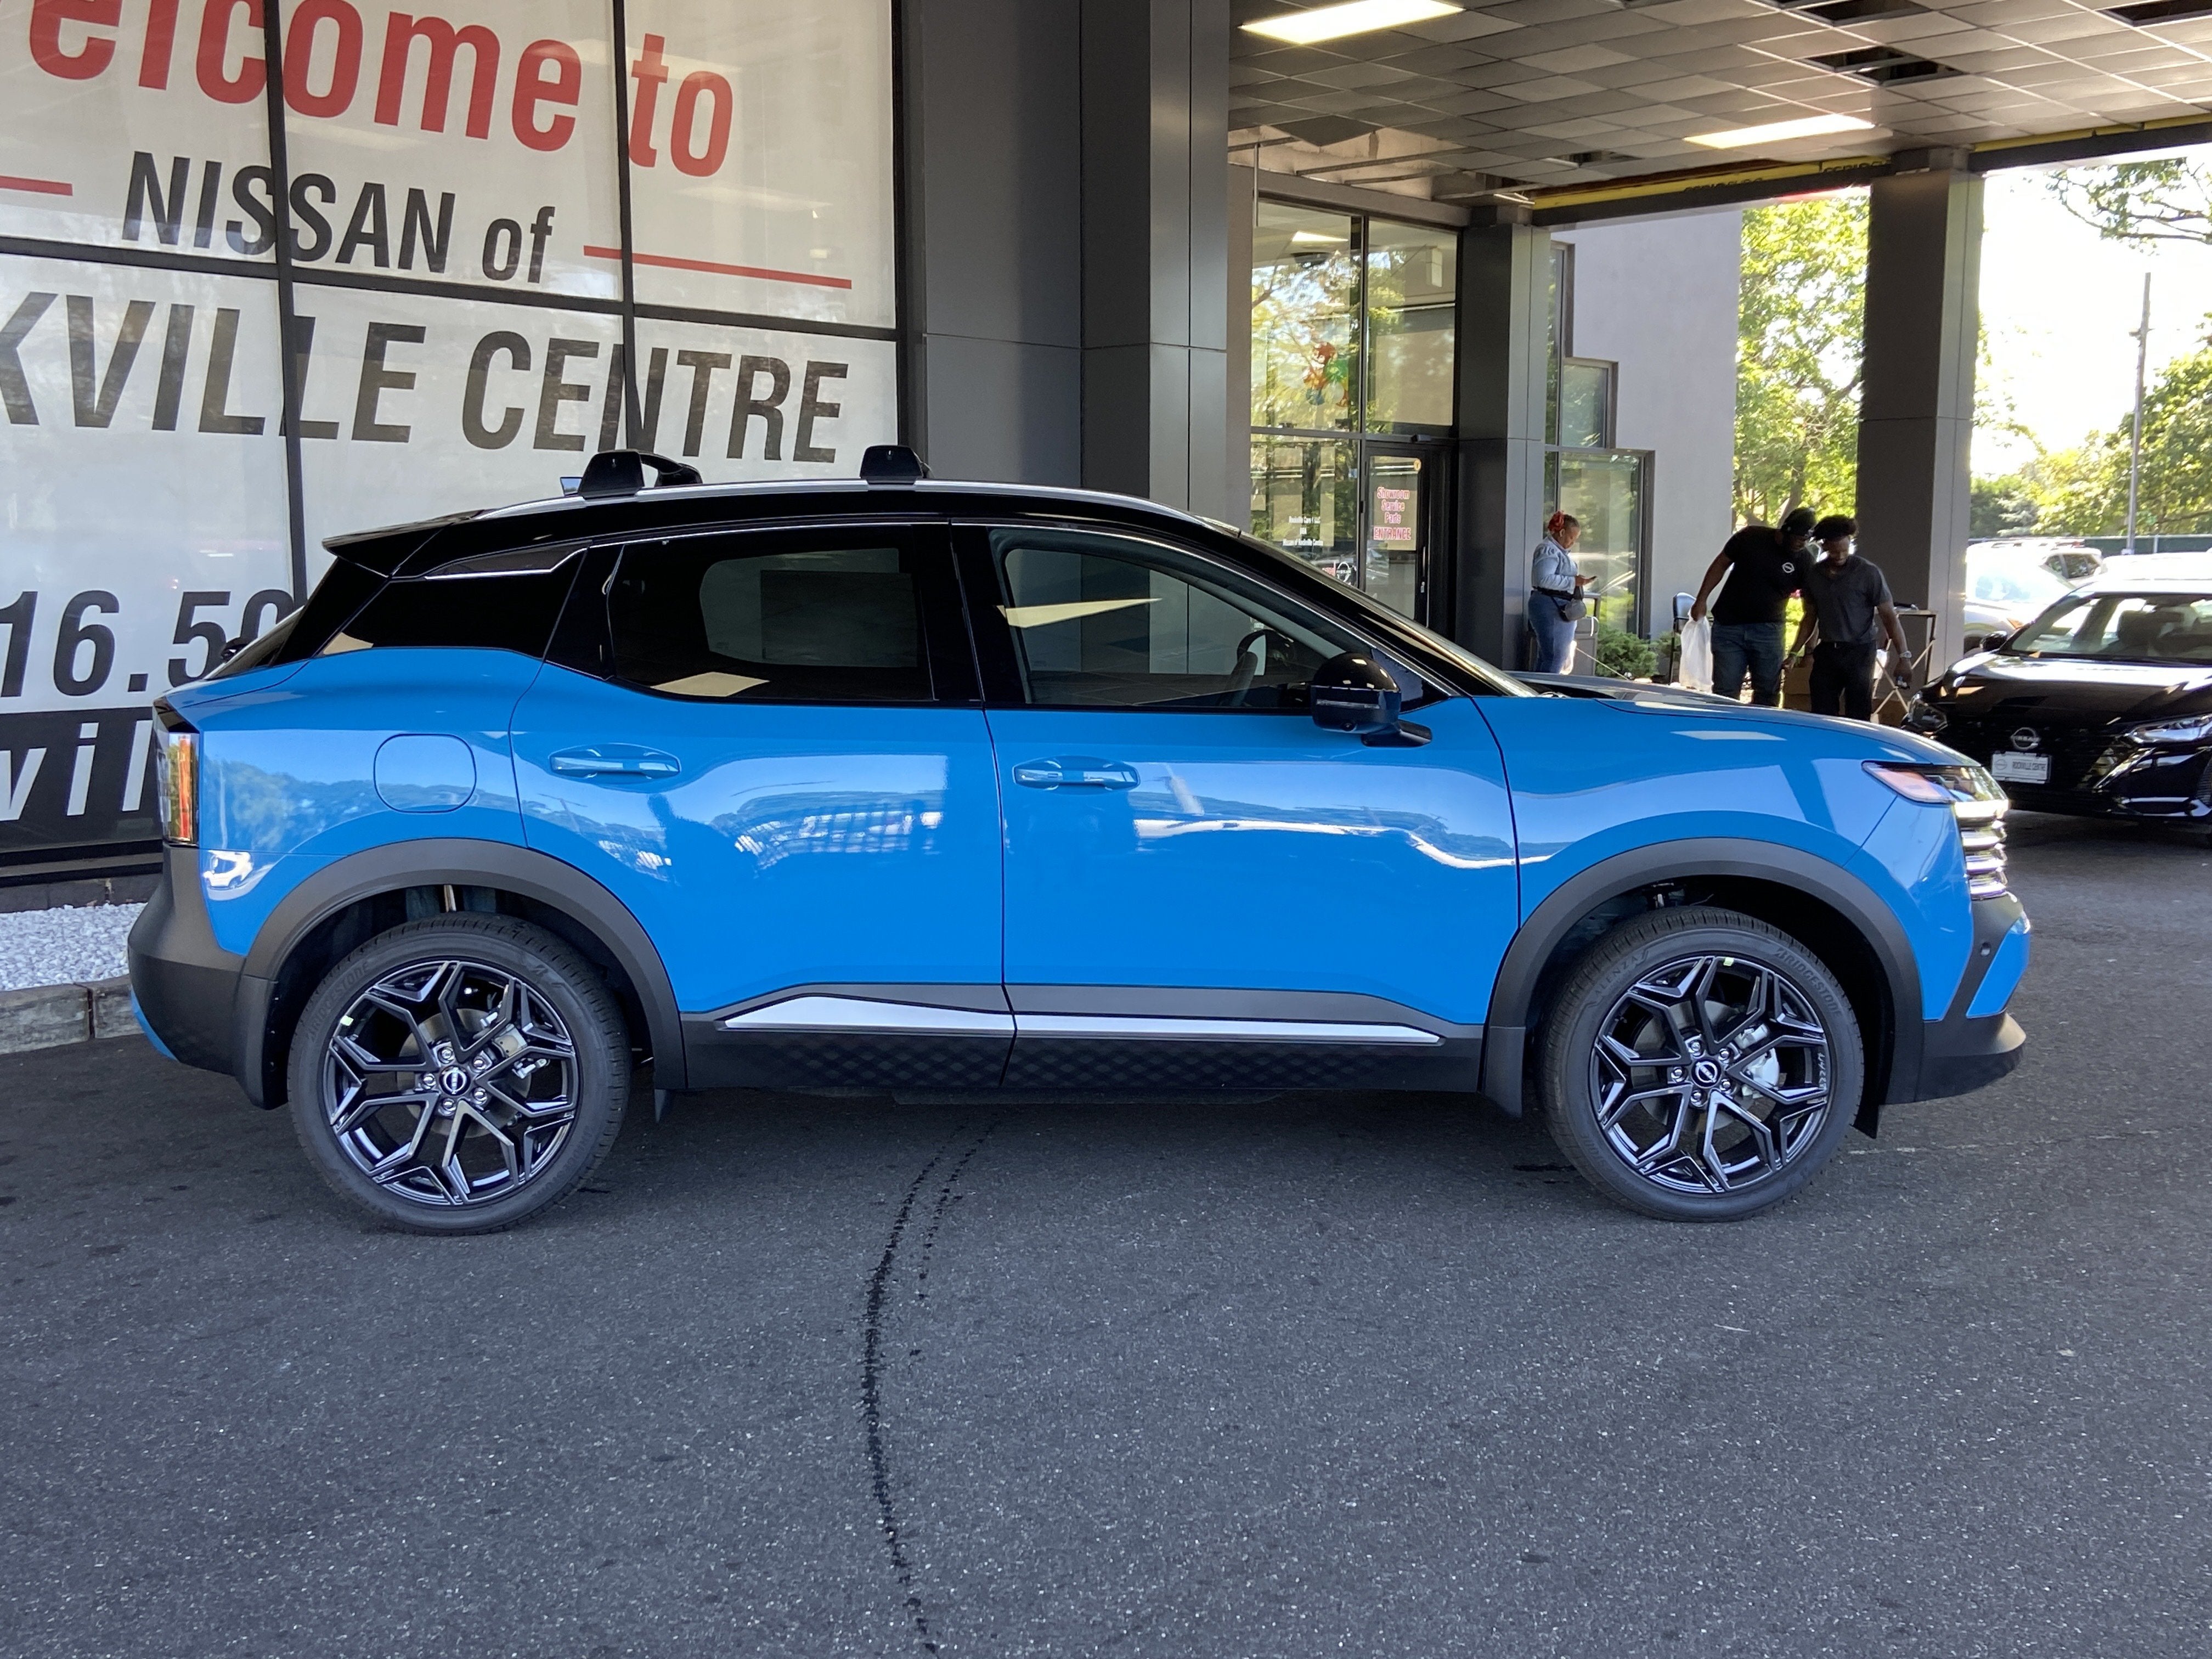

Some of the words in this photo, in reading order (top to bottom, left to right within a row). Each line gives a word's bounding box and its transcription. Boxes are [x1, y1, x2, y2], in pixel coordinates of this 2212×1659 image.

[628, 32, 733, 178] to
[122, 151, 456, 273] NISSAN
[482, 206, 555, 284] of
[462, 330, 849, 463] CENTRE
[1377, 486, 1410, 500] Showroom
[1381, 499, 1405, 512] Service
[1373, 527, 1411, 540] ENTRANCE
